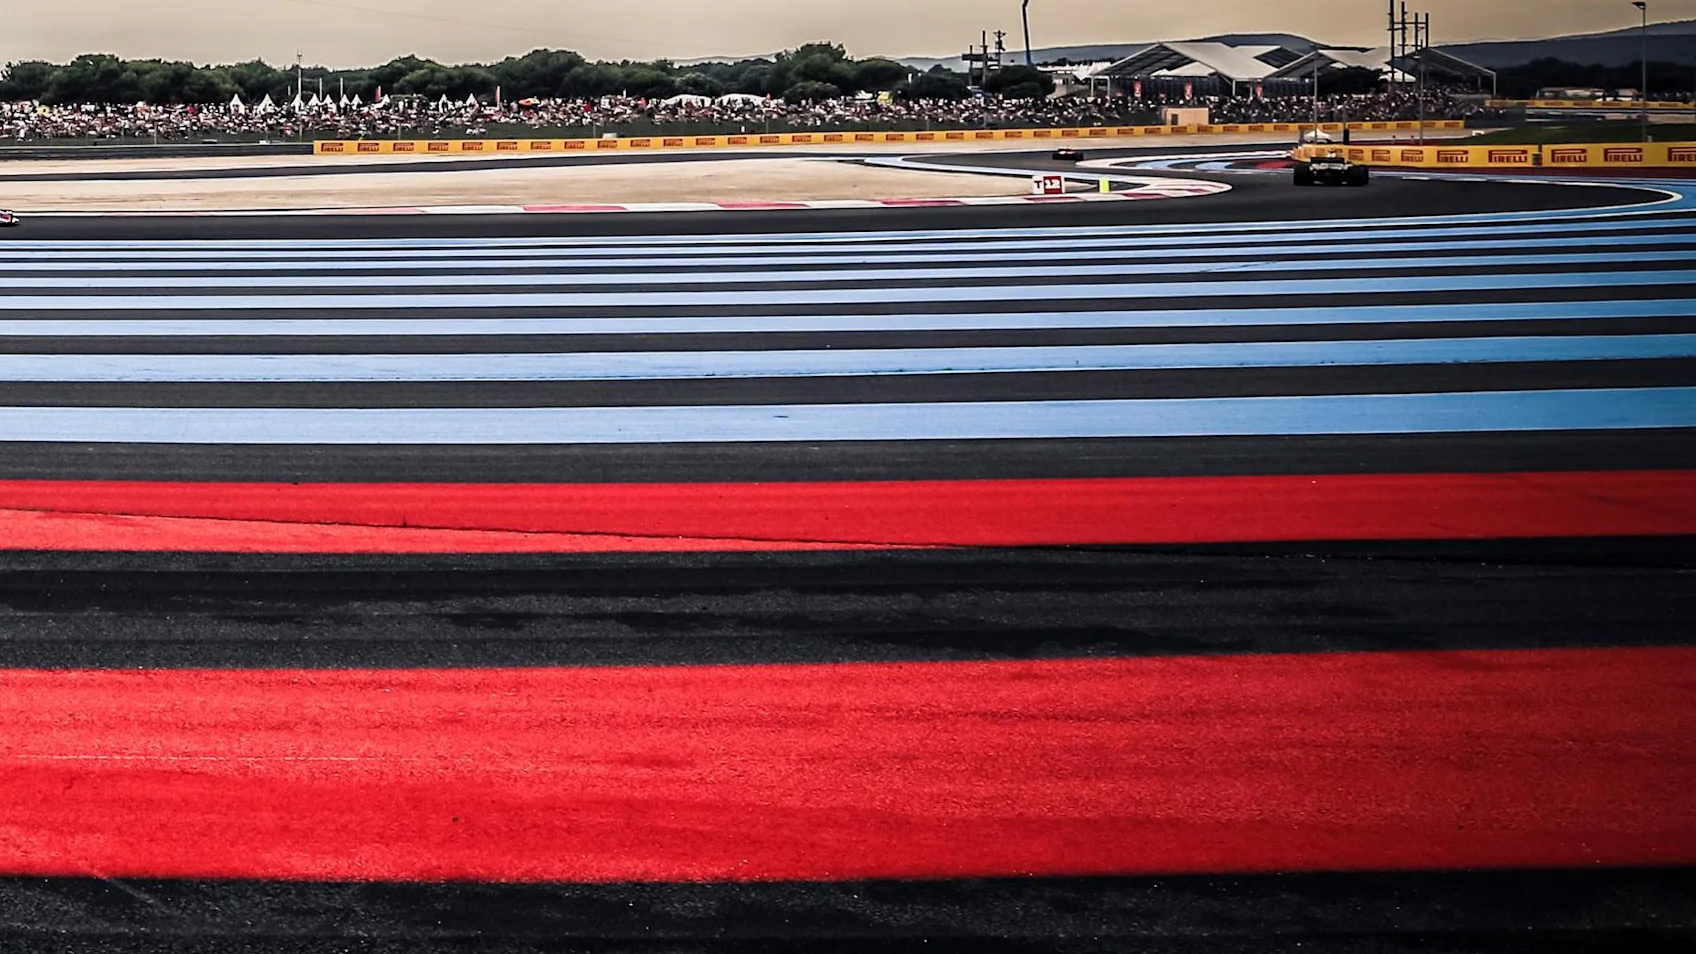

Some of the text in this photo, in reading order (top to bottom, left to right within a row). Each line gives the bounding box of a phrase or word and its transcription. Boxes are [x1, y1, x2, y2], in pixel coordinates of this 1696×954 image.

[1401, 150, 1423, 162] PIRELLI
[1437, 150, 1469, 163] PIRELLI
[1488, 150, 1528, 163] PIRELLI
[1551, 147, 1696, 163] PIRELLI PIRELLI PIRE
